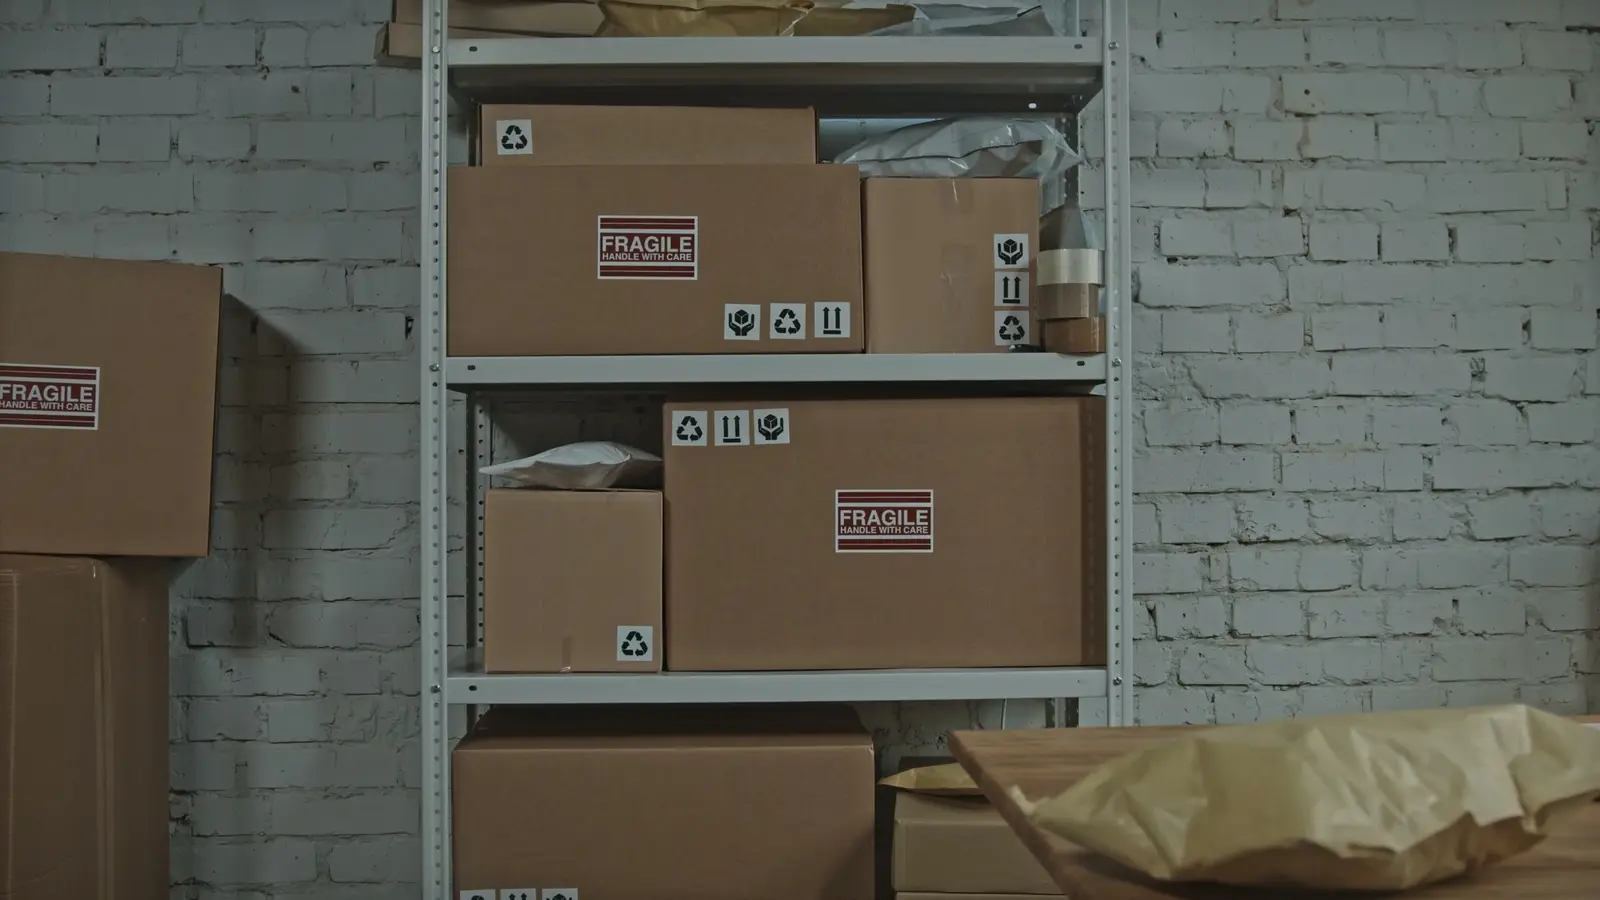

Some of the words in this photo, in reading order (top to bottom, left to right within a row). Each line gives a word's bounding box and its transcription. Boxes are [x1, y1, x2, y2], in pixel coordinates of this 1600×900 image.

[602, 235, 692, 252] FRAGILE
[0, 384, 93, 402] FRAGILE
[0, 401, 37, 409] HANDLE
[40, 402, 64, 410] WITH
[66, 403, 92, 411] CARE
[840, 509, 928, 525] FRAGILE
[840, 526, 876, 534] HANDLE
[879, 526, 901, 534] WITH
[903, 526, 928, 534] CARE
